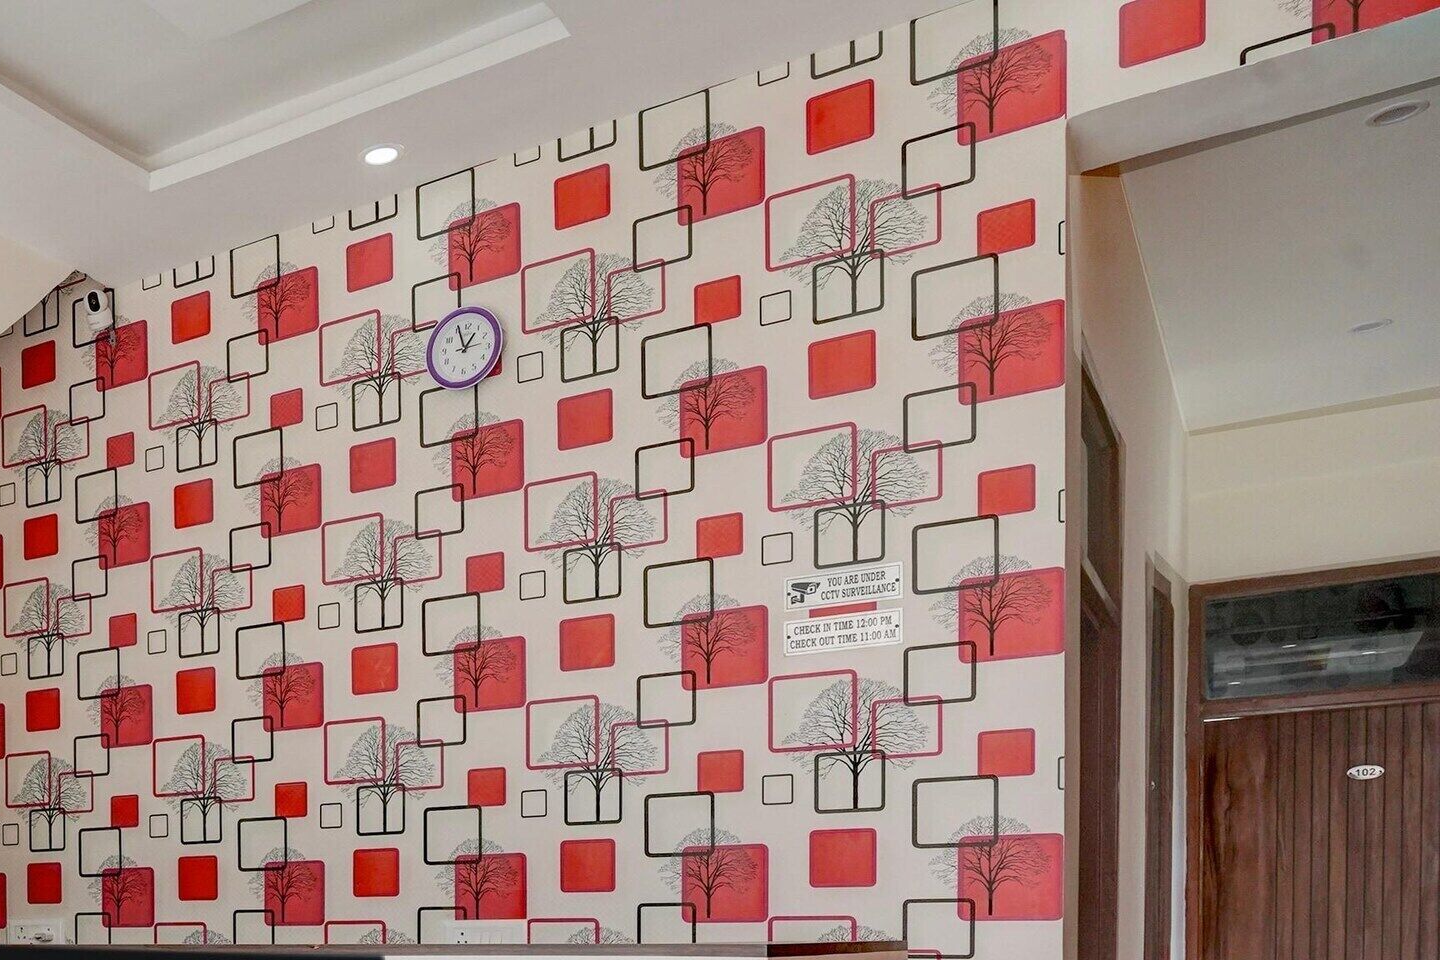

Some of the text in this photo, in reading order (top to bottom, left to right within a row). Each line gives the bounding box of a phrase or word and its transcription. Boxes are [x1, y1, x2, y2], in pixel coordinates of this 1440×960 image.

[827, 570, 886, 588] YOU ARE UNDER
[820, 582, 896, 601] CCTV SURVEILLANCE
[793, 615, 893, 636] CHECK IN TIME 12:00 PM
[789, 628, 897, 650] CHECK OUT TIME 11:00 AM
[1355, 767, 1376, 776] 102
